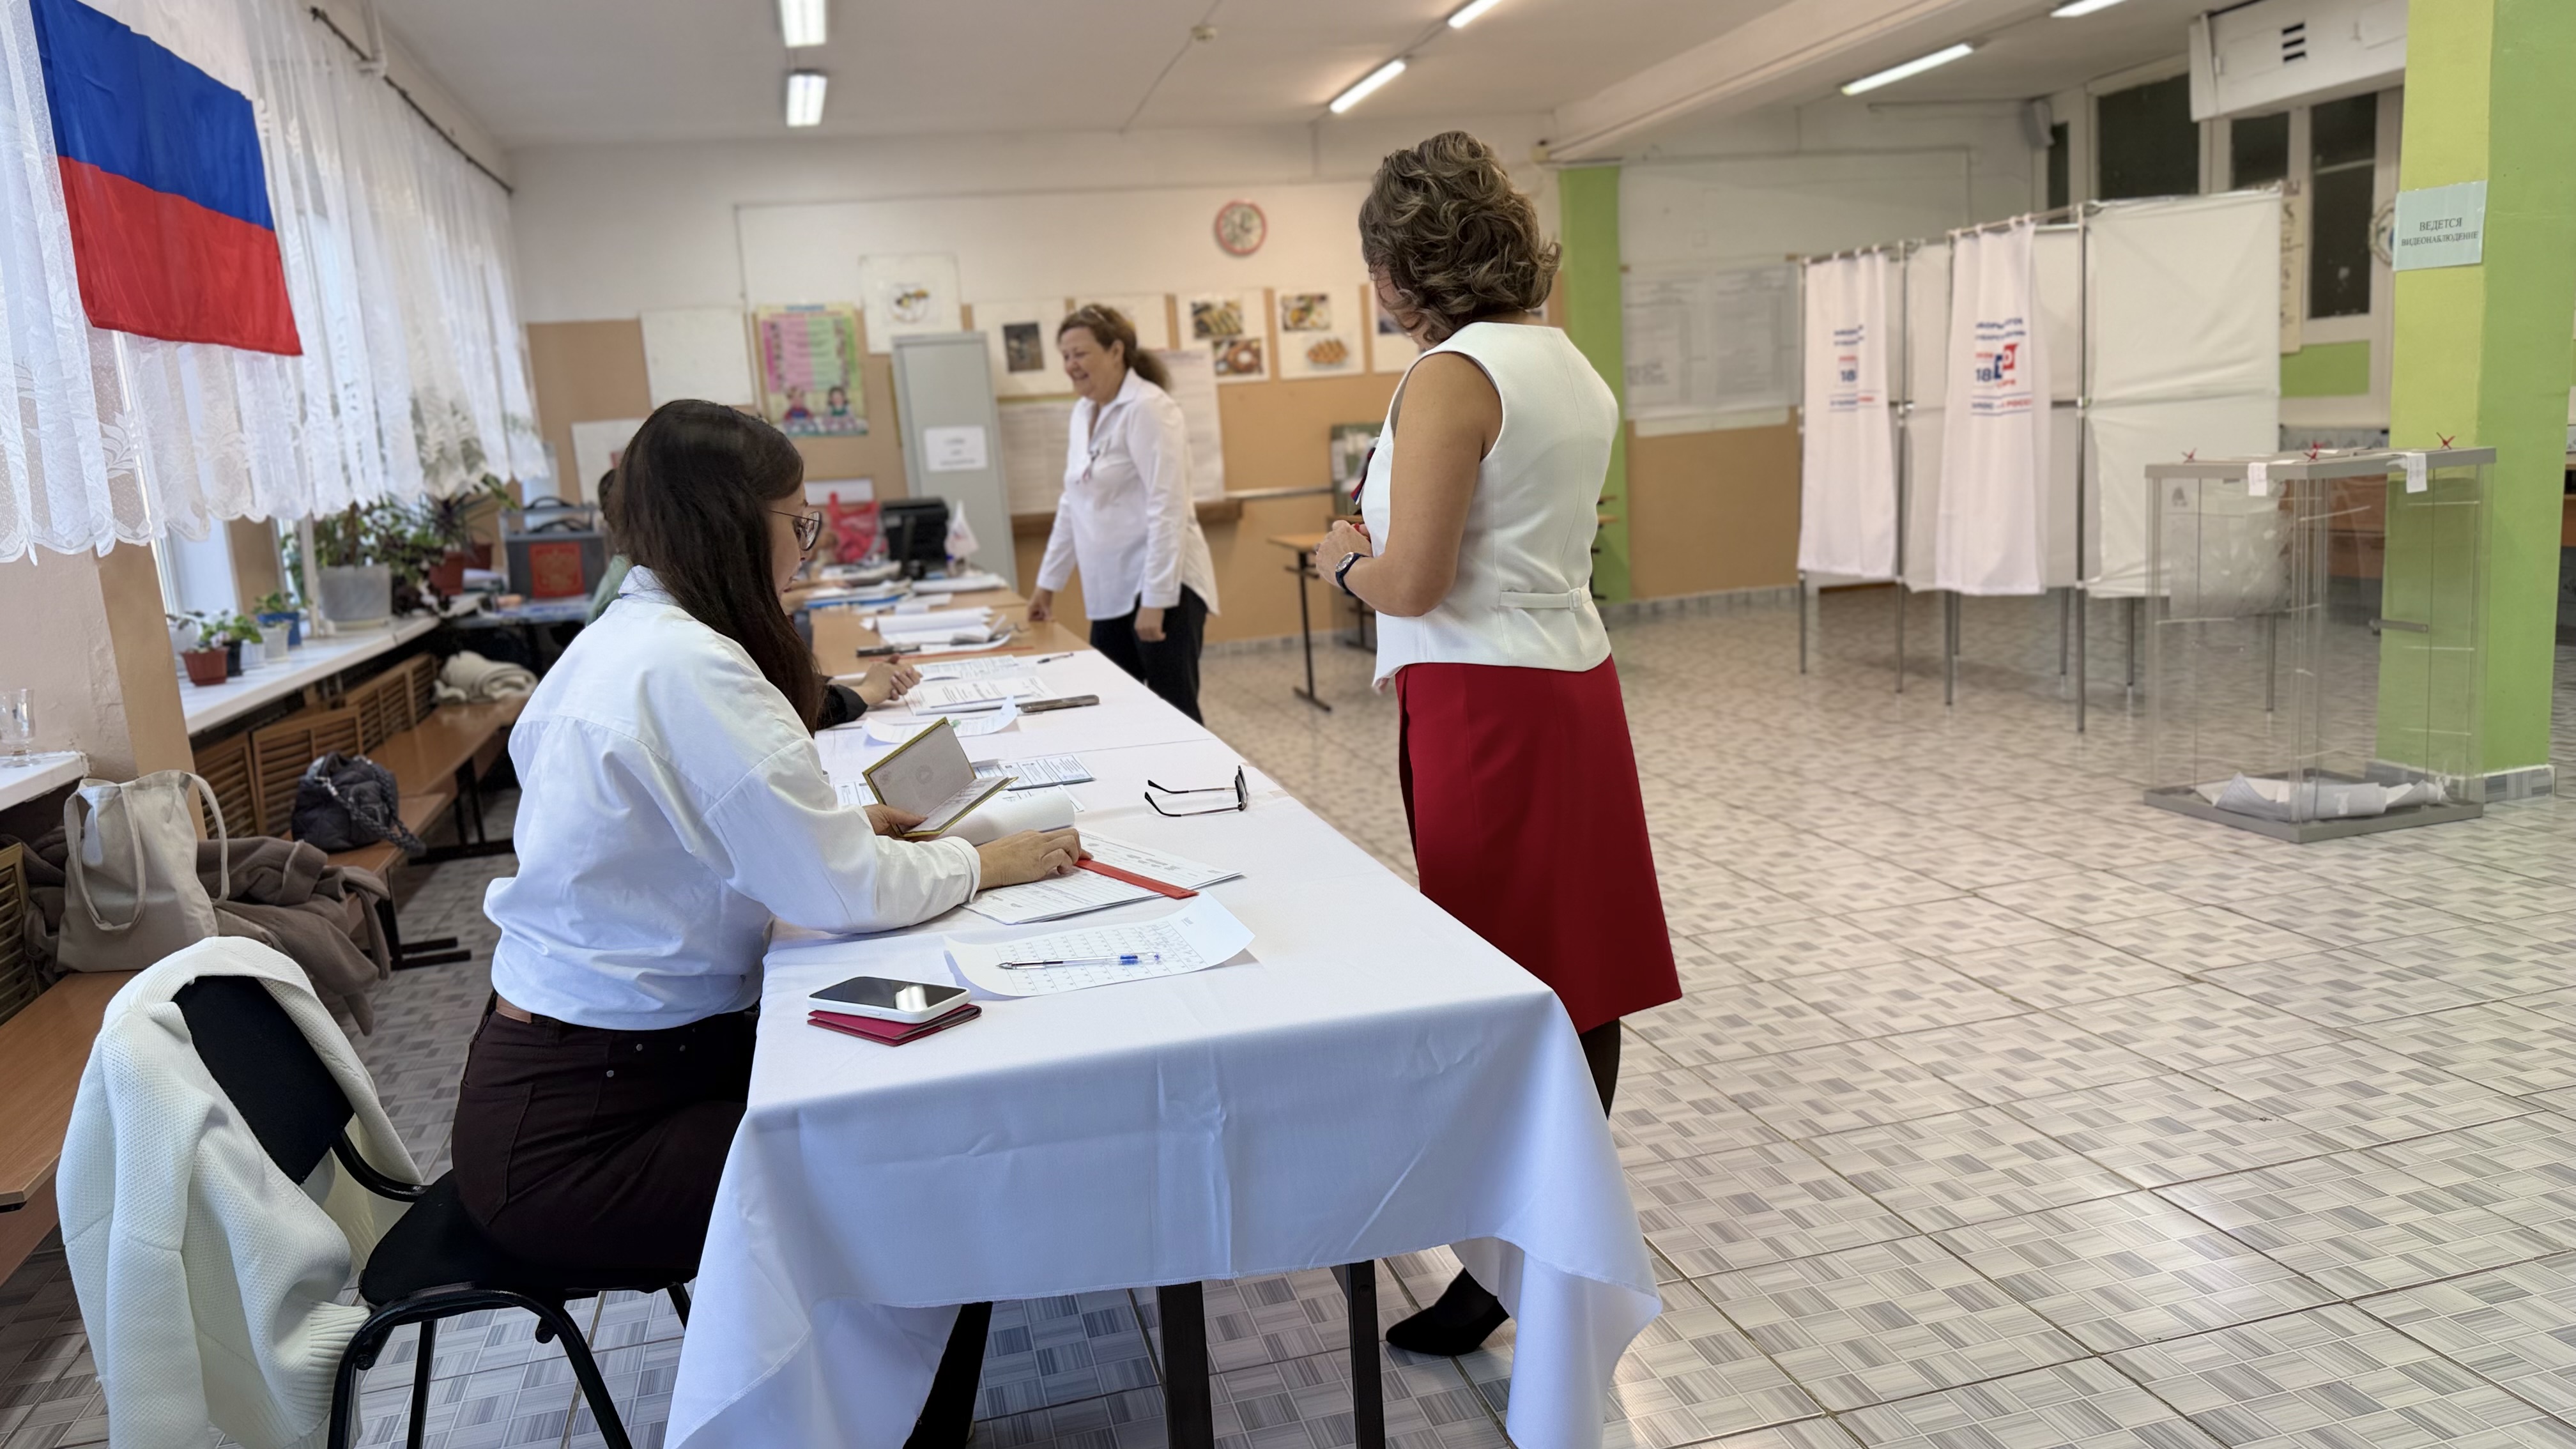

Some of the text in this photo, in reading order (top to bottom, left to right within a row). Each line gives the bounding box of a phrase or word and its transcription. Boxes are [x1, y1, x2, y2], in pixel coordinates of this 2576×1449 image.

[2419, 217, 2462, 231] ВЕДЕТСЯ
[2402, 231, 2478, 246] ВИДЕОНАБЛЮДЕНИЕ
[1975, 368, 1991, 381] 18
